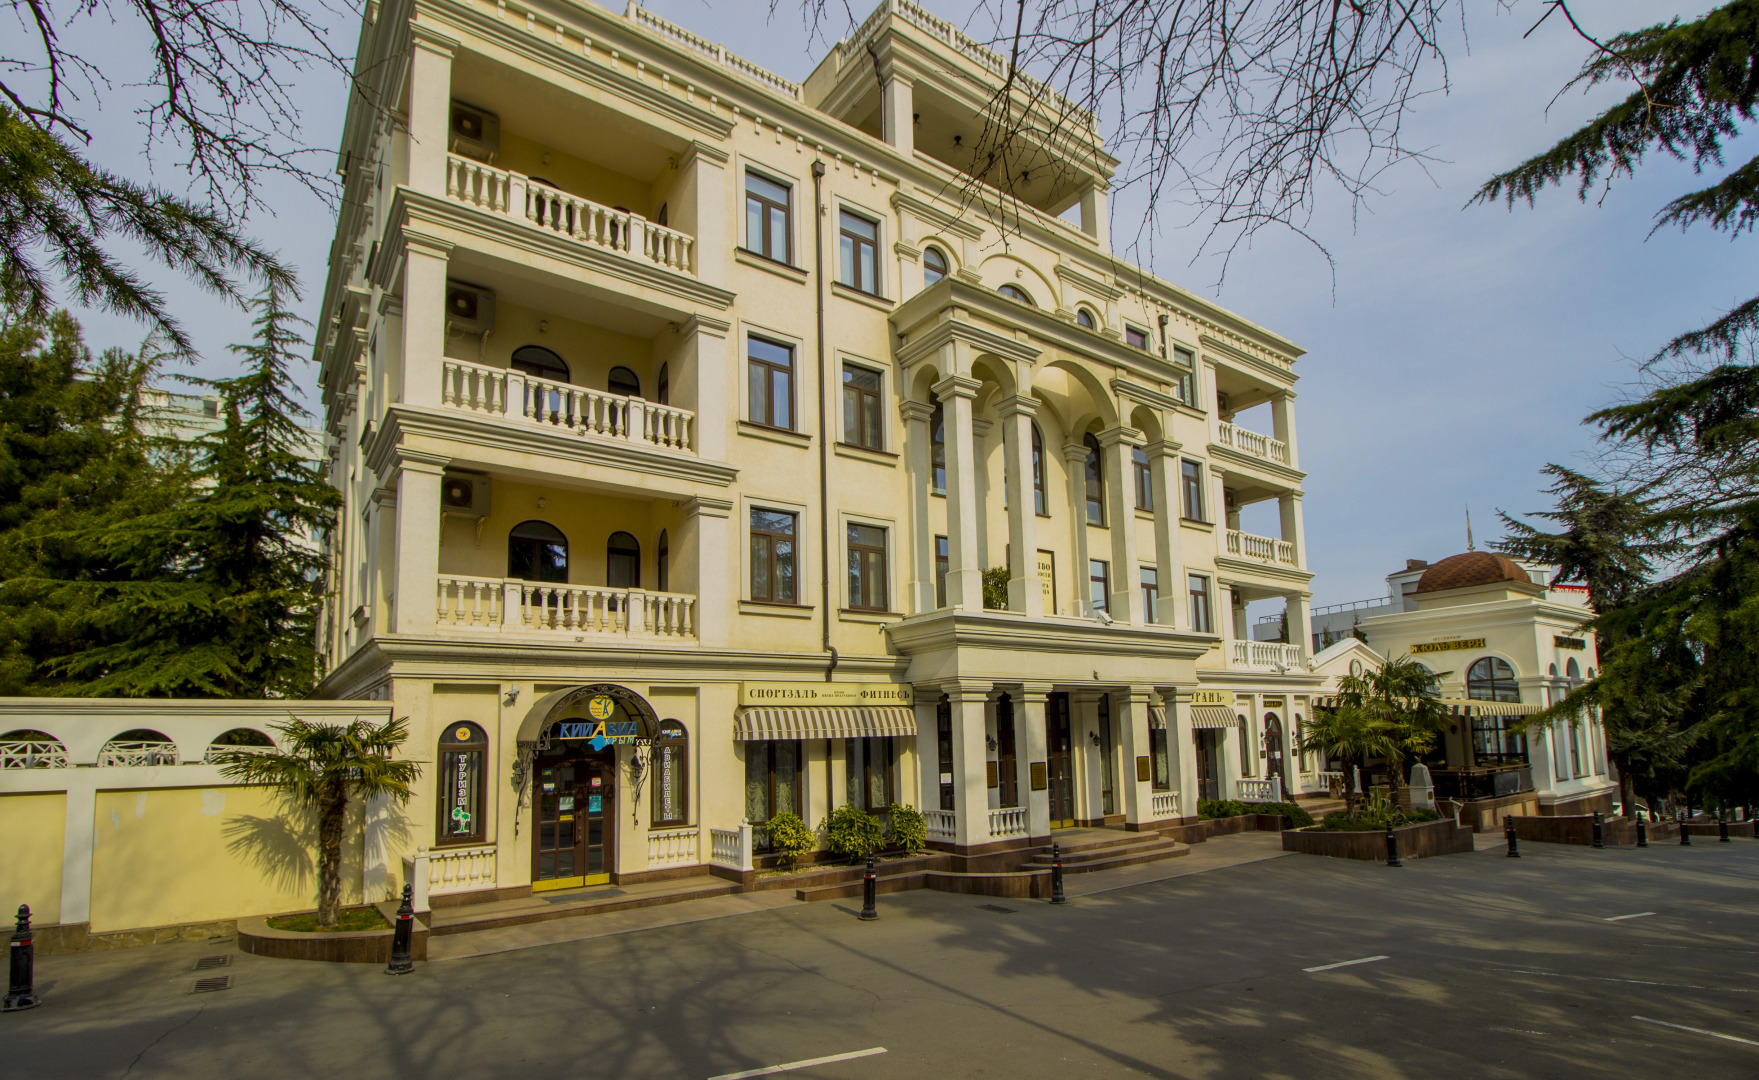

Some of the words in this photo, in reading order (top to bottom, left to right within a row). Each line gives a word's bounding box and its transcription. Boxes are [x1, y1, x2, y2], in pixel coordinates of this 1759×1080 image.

[1411, 642, 1448, 653] ЖЮЛЬ
[1453, 638, 1486, 650] ВЕРН
[749, 689, 818, 699] СПОРТЗАЛЪ
[860, 690, 910, 699] ФИТНЕСЪ
[458, 754, 467, 805] ТУРИЗМ
[664, 746, 673, 820] АВИАБИЛЕТЫ
